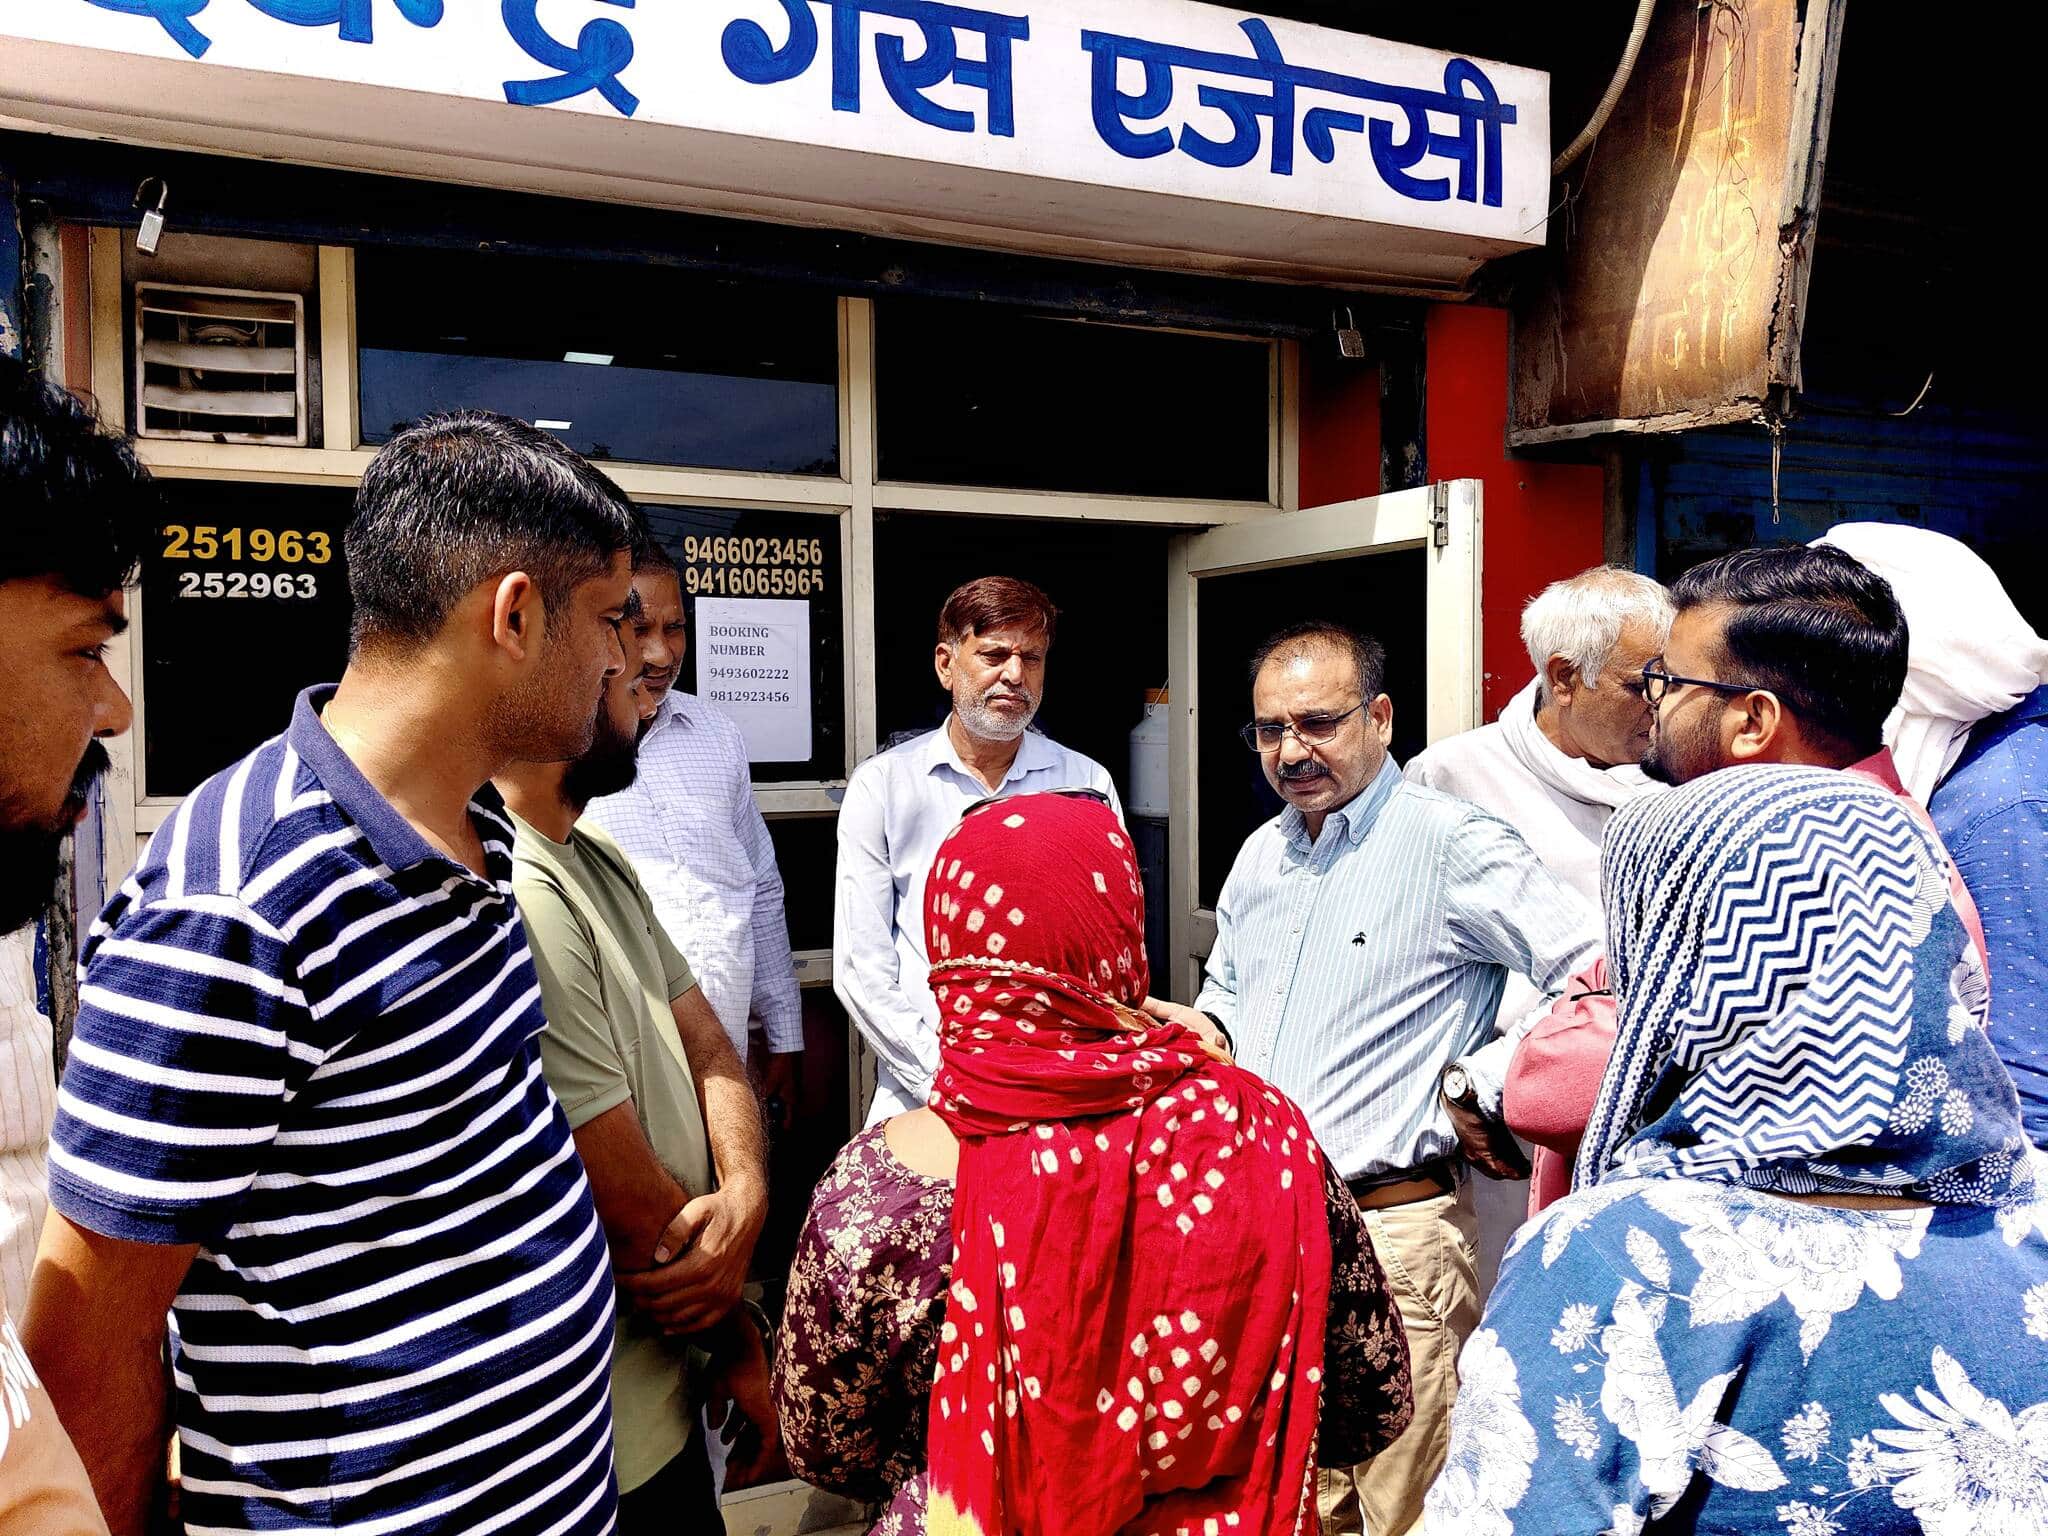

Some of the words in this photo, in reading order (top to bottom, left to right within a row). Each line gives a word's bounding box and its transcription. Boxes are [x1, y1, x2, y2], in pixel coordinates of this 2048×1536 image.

[721, 0, 1030, 138] गस
[1081, 17, 1518, 208] एजेन्सी
[163, 525, 332, 564] 251963
[684, 536, 823, 566] 9466023456
[178, 572, 318, 599] 252963
[685, 567, 824, 595] 9416065965
[709, 625, 769, 639] BOOKING
[709, 644, 766, 657] NUMBER
[709, 667, 789, 680] 9493602222
[709, 690, 790, 703] 9812923456
